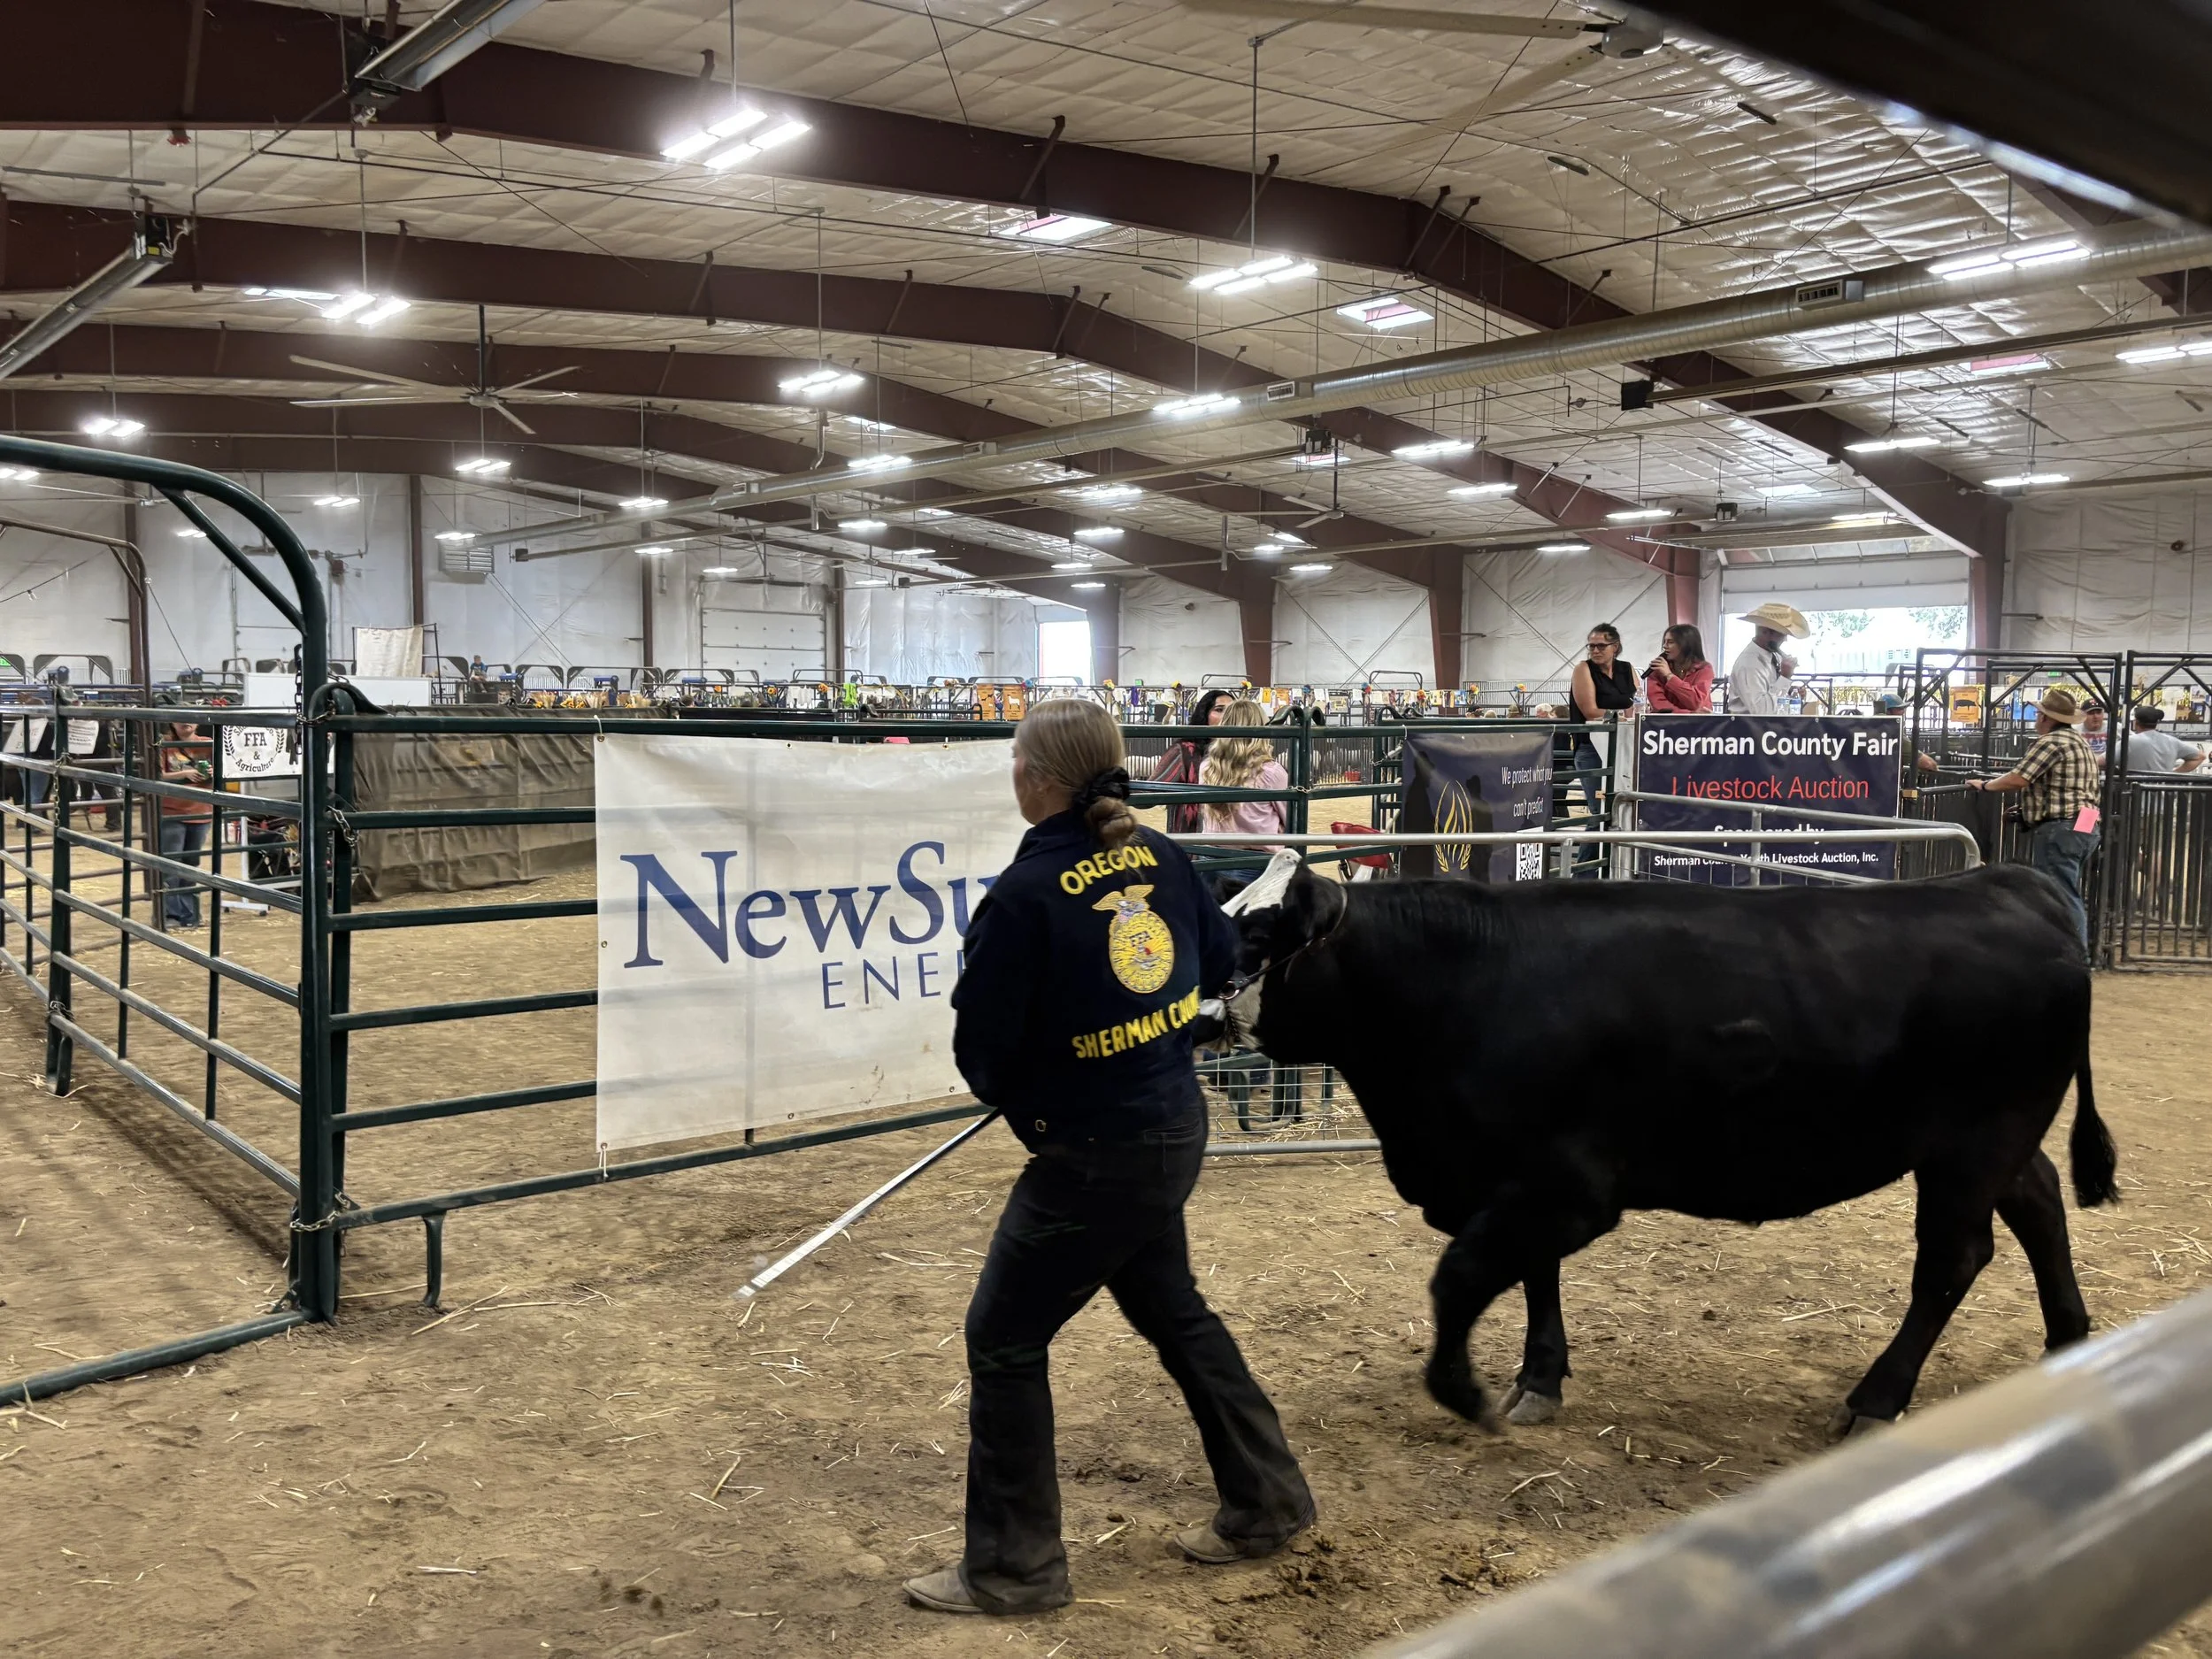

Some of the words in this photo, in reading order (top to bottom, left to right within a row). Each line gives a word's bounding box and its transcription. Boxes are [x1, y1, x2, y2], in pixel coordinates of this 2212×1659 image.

[244, 733, 267, 747] FFA
[1643, 729, 1754, 756] Sherman
[1761, 731, 1847, 761] County
[1853, 732, 1898, 757] Fair
[235, 757, 274, 772] Agriculture
[1502, 766, 1511, 785] We
[1511, 766, 1532, 788] protect
[1532, 765, 1544, 782] what
[1671, 774, 1782, 799] Livestock
[1788, 775, 1869, 800] Auction
[1513, 798, 1527, 817] can't
[1060, 845, 1159, 895] OREGON
[1654, 855, 1701, 866] Sherman
[1772, 853, 1818, 864] Livestock
[1822, 852, 1860, 864] Auction,
[1863, 852, 1879, 863] Inc.
[619, 841, 999, 969] NewSu
[1071, 1010, 1169, 1058] SHERMAN
